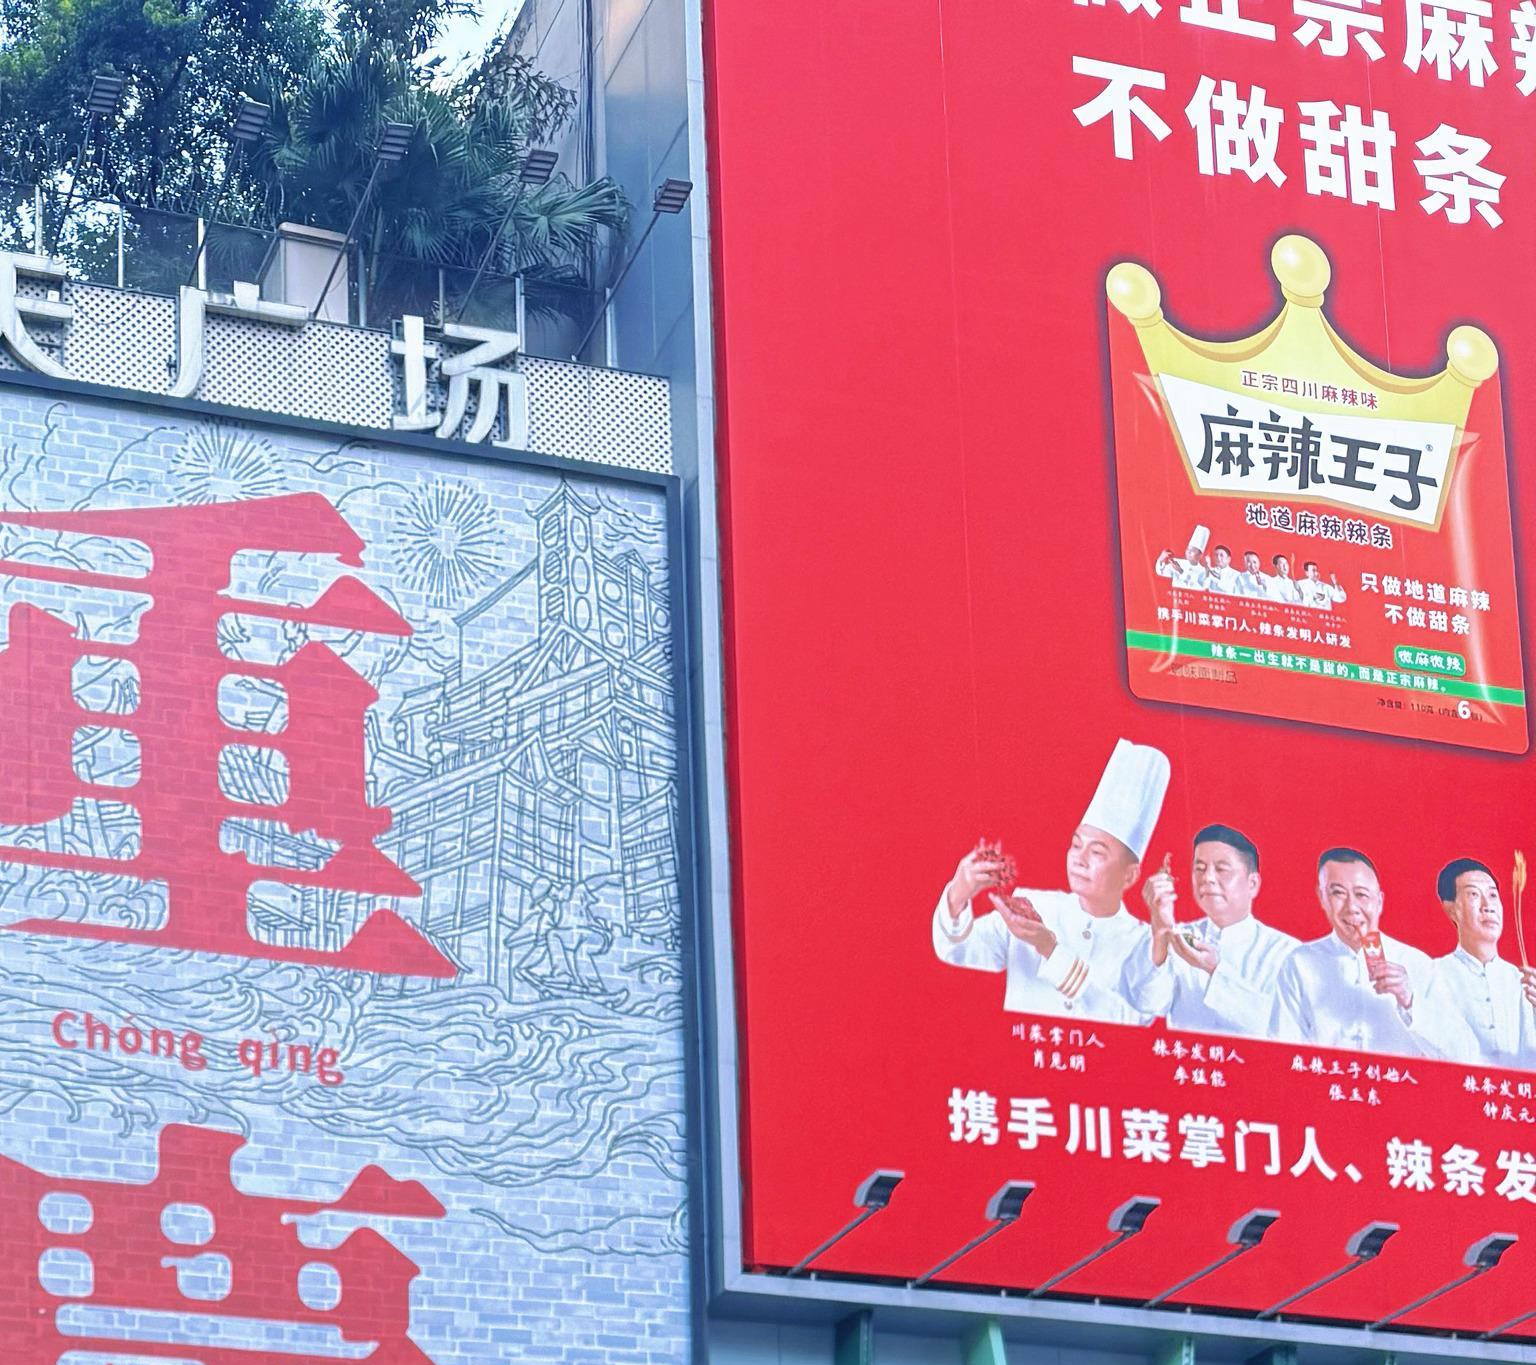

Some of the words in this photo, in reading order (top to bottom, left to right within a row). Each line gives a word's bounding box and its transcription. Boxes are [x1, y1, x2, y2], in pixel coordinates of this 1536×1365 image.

[1072, 55, 1507, 229] 不做甜条
[1241, 370, 1379, 410] 正宗四川麻辣味
[1196, 403, 1438, 512] 麻辣王子
[1245, 503, 1393, 549] 地道麻辣辣条
[1360, 572, 1491, 611] 只做地道麻辣
[1384, 603, 1470, 635] 不做甜条
[1397, 649, 1463, 672] 微麻微辣
[1012, 1023, 1105, 1048] 川菜掌门人
[1152, 1038, 1245, 1064] 辣条发明人
[1291, 1054, 1419, 1085] 麻辣王子创始人
[1462, 1075, 1536, 1101] 辣条发明
